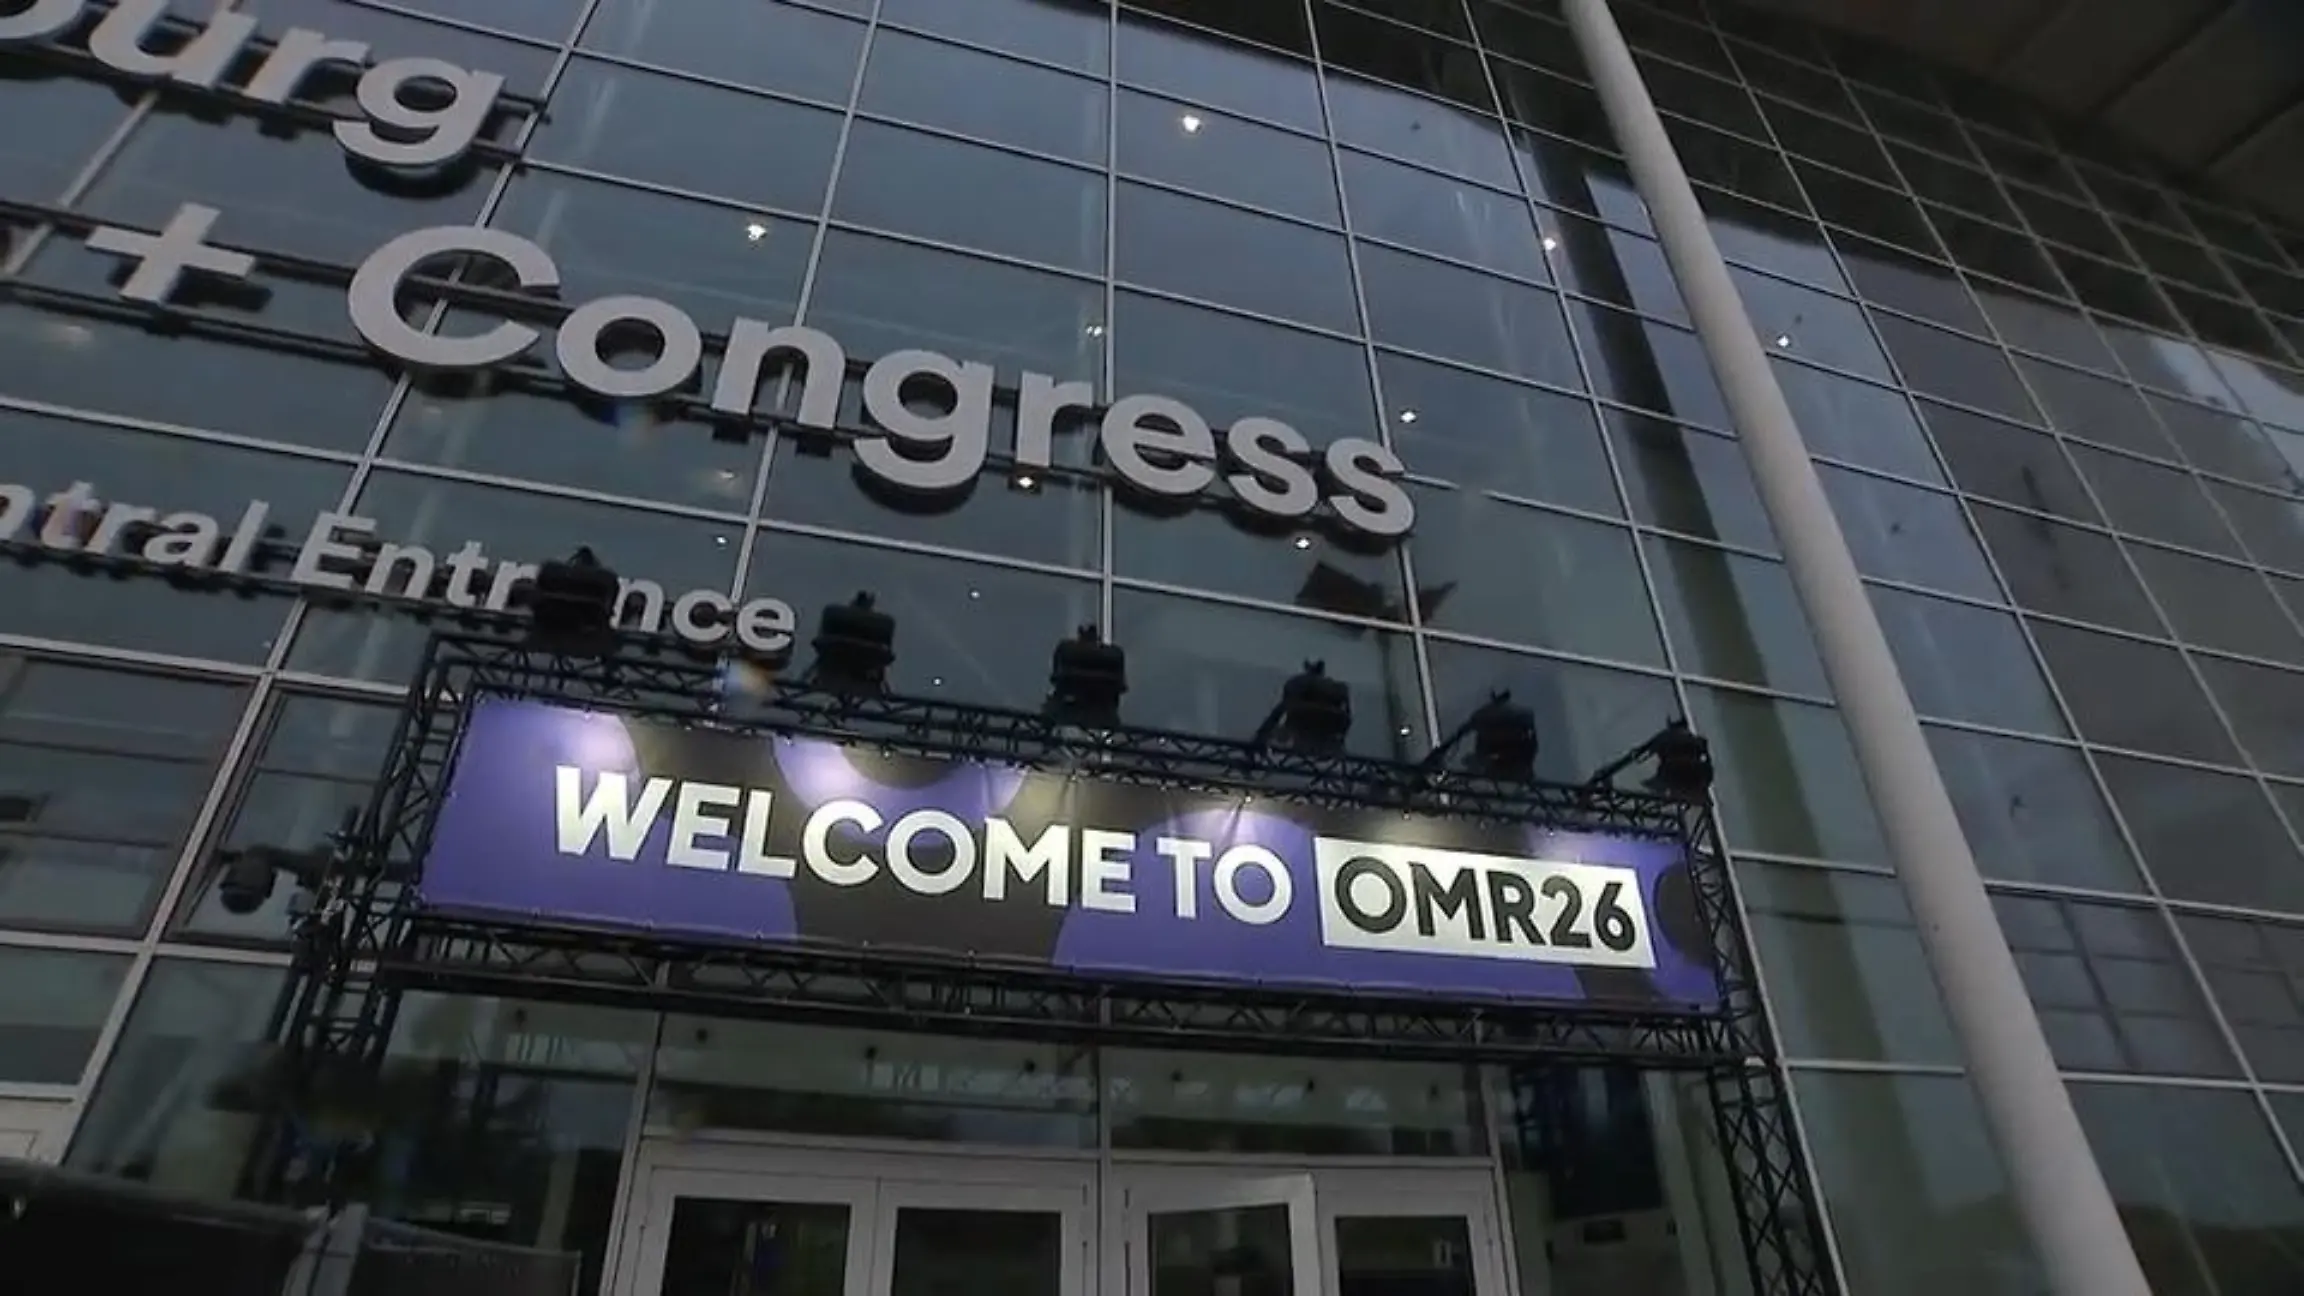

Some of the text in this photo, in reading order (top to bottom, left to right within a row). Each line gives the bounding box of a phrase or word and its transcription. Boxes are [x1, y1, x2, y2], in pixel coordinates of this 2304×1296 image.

[85, 202, 1415, 536] + Congress
[291, 511, 796, 651] Entrnce
[555, 765, 1636, 953] WELCOME TO OMR26
